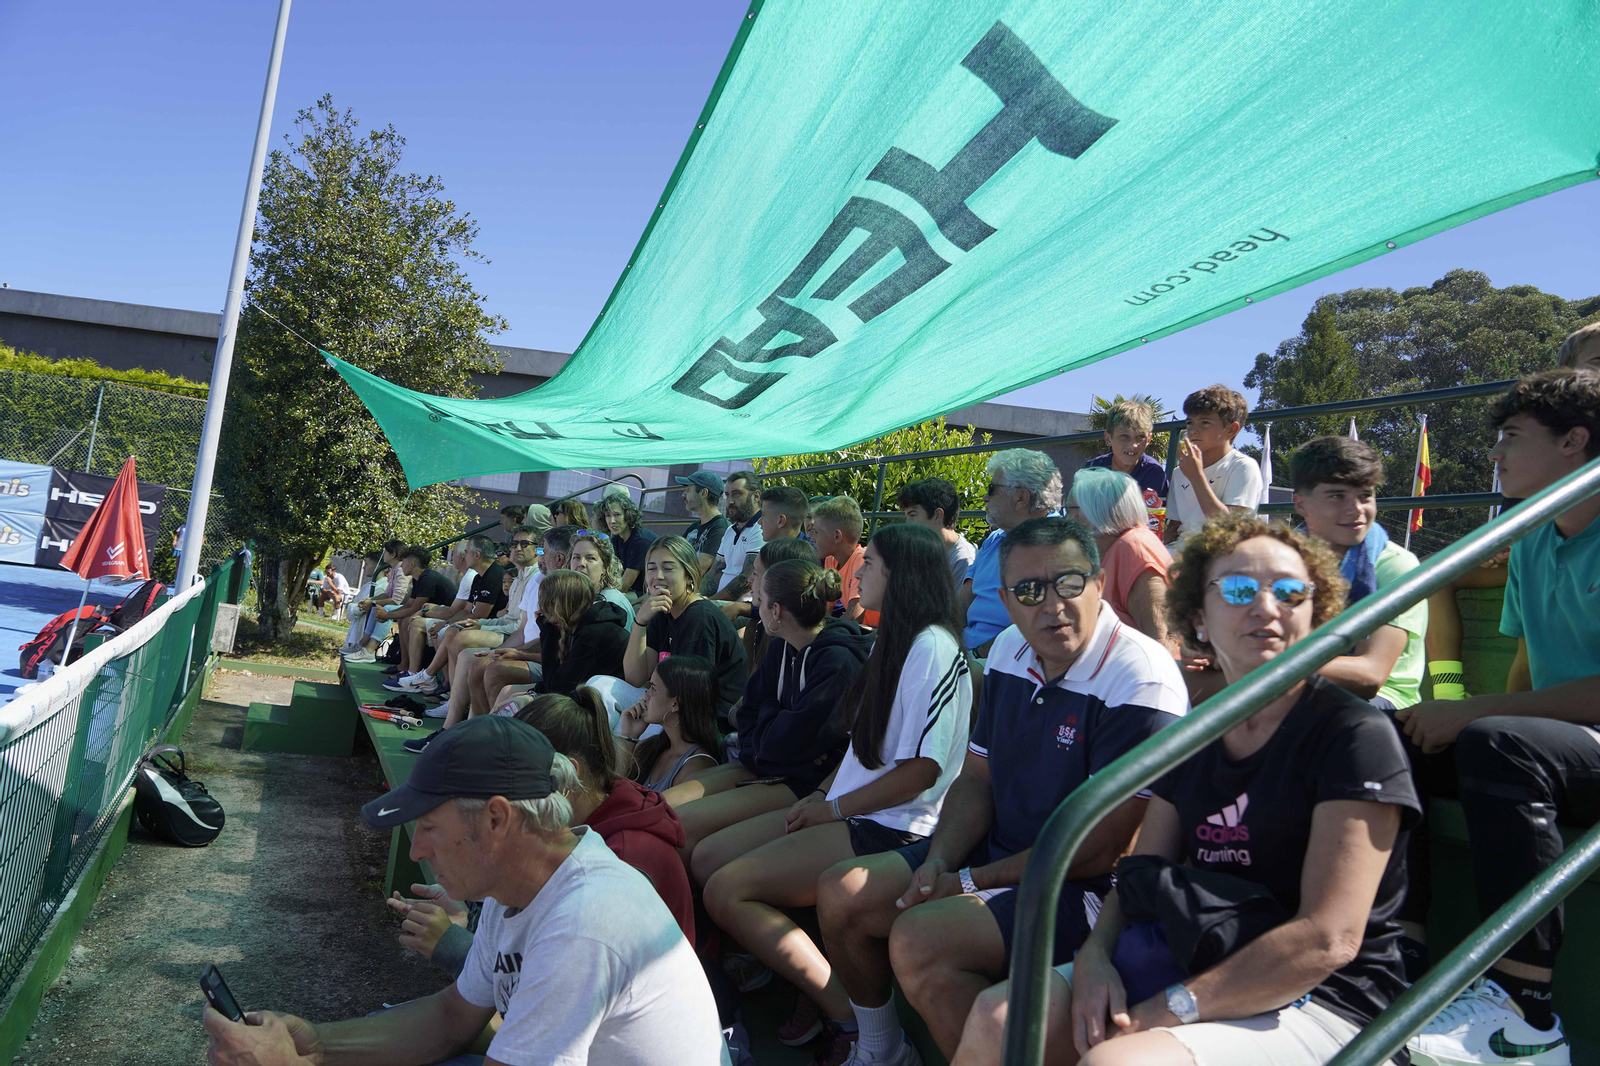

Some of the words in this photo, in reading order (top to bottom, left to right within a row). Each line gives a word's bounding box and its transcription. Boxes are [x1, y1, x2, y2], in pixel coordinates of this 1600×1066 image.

[671, 19, 1120, 410] HEAD
[1123, 227, 1290, 306] head.com
[50, 487, 157, 515] HED
[0, 526, 21, 546] is
[22, 632, 57, 679] HEAD
[1195, 824, 1250, 843] adas
